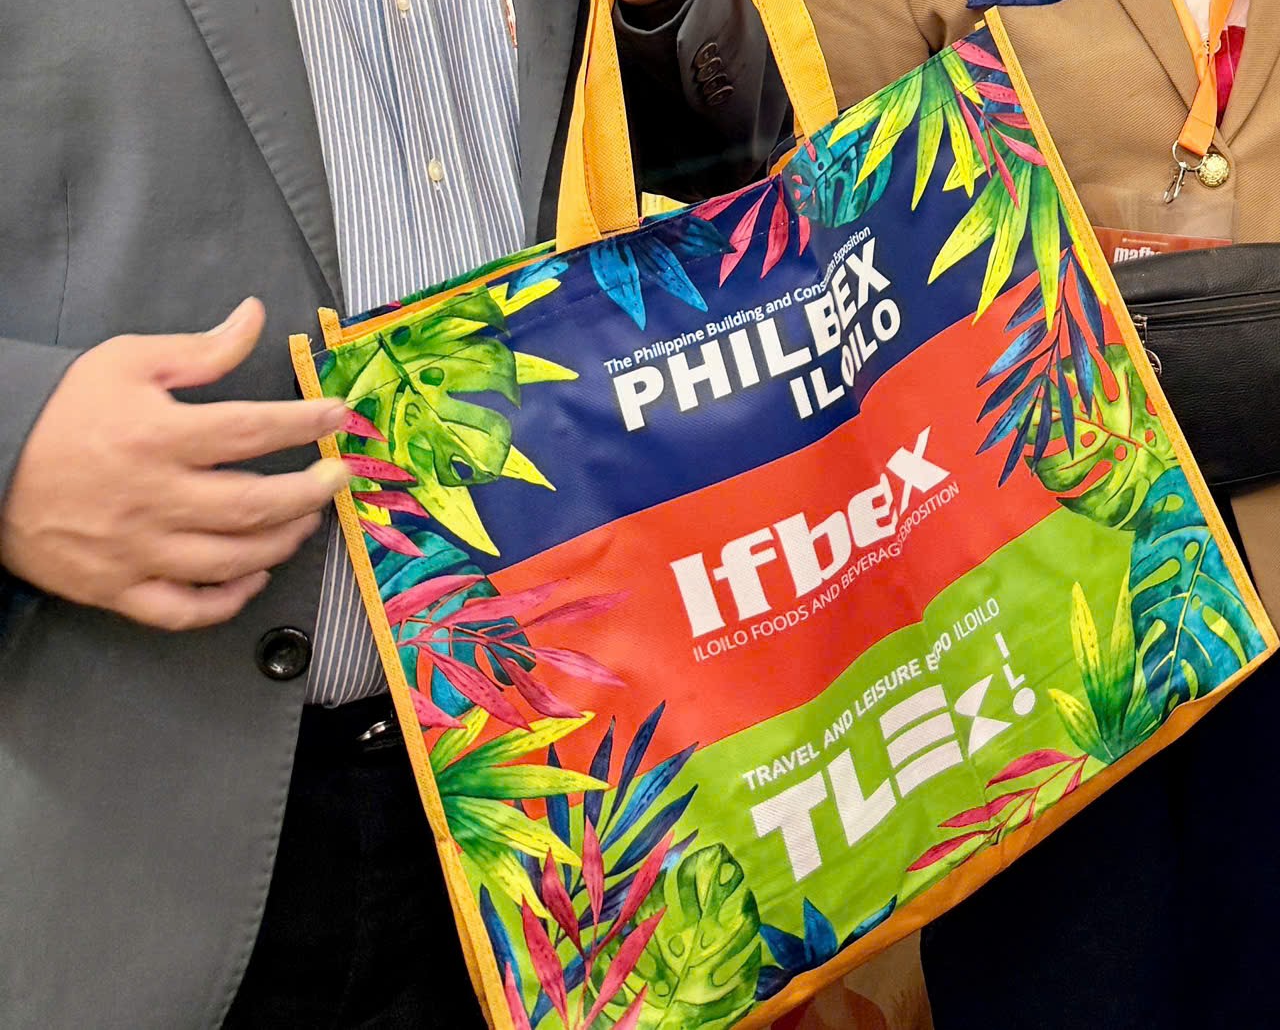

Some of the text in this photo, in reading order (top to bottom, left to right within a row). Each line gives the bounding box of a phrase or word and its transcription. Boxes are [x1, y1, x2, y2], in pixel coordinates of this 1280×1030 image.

[603, 356, 633, 375] The
[633, 327, 705, 366] Philippine
[705, 303, 765, 336] Building
[765, 291, 793, 314] and
[833, 226, 871, 265] Exposition
[612, 236, 892, 433] PHILBEX
[790, 298, 901, 420] ILOILO
[669, 425, 952, 639] Ifbex
[692, 630, 749, 663] ILOILO
[751, 605, 809, 641] FOODS
[811, 583, 841, 615] AND
[899, 481, 960, 541] EXPOSITION
[742, 742, 821, 791] TRAVEL
[823, 709, 853, 750] AND
[854, 658, 922, 718] LEISURE
[953, 596, 1000, 642] ILOILO
